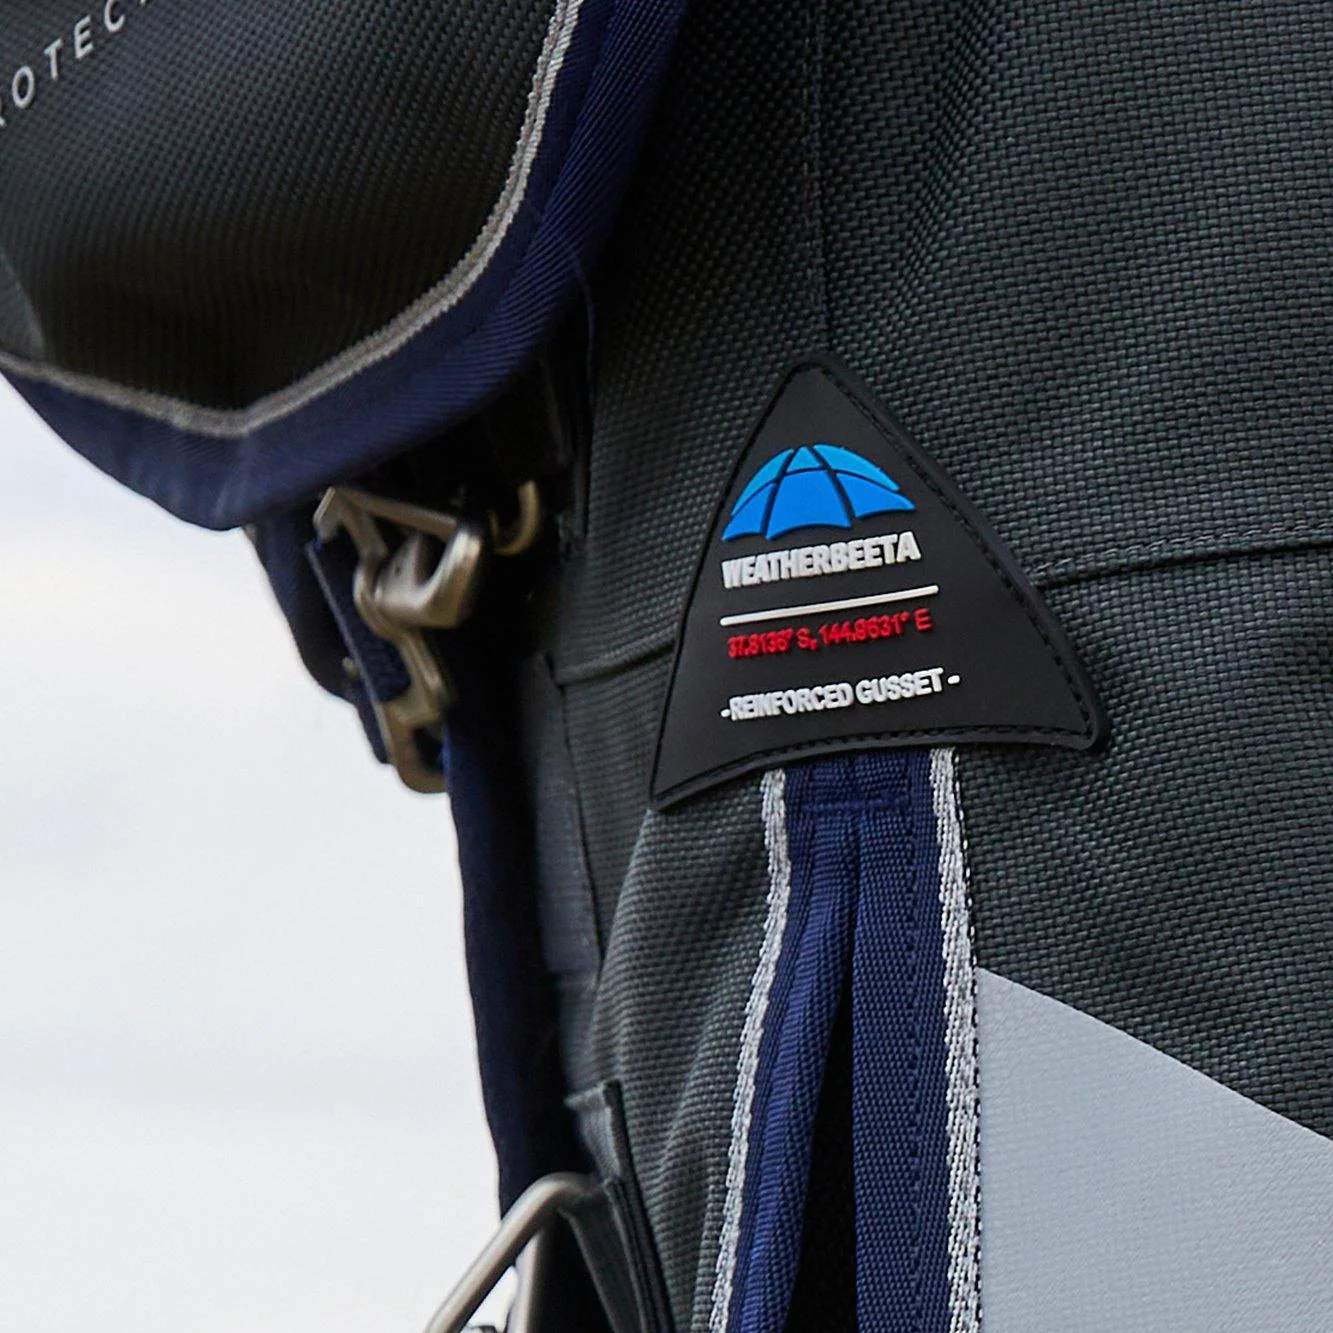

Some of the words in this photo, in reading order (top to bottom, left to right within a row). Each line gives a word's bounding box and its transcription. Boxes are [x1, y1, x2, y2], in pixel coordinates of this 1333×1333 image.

[0, 0, 148, 127] OTEC
[721, 531, 922, 589] WEATHERBEETA
[796, 627, 819, 650] S,
[914, 608, 933, 631] E
